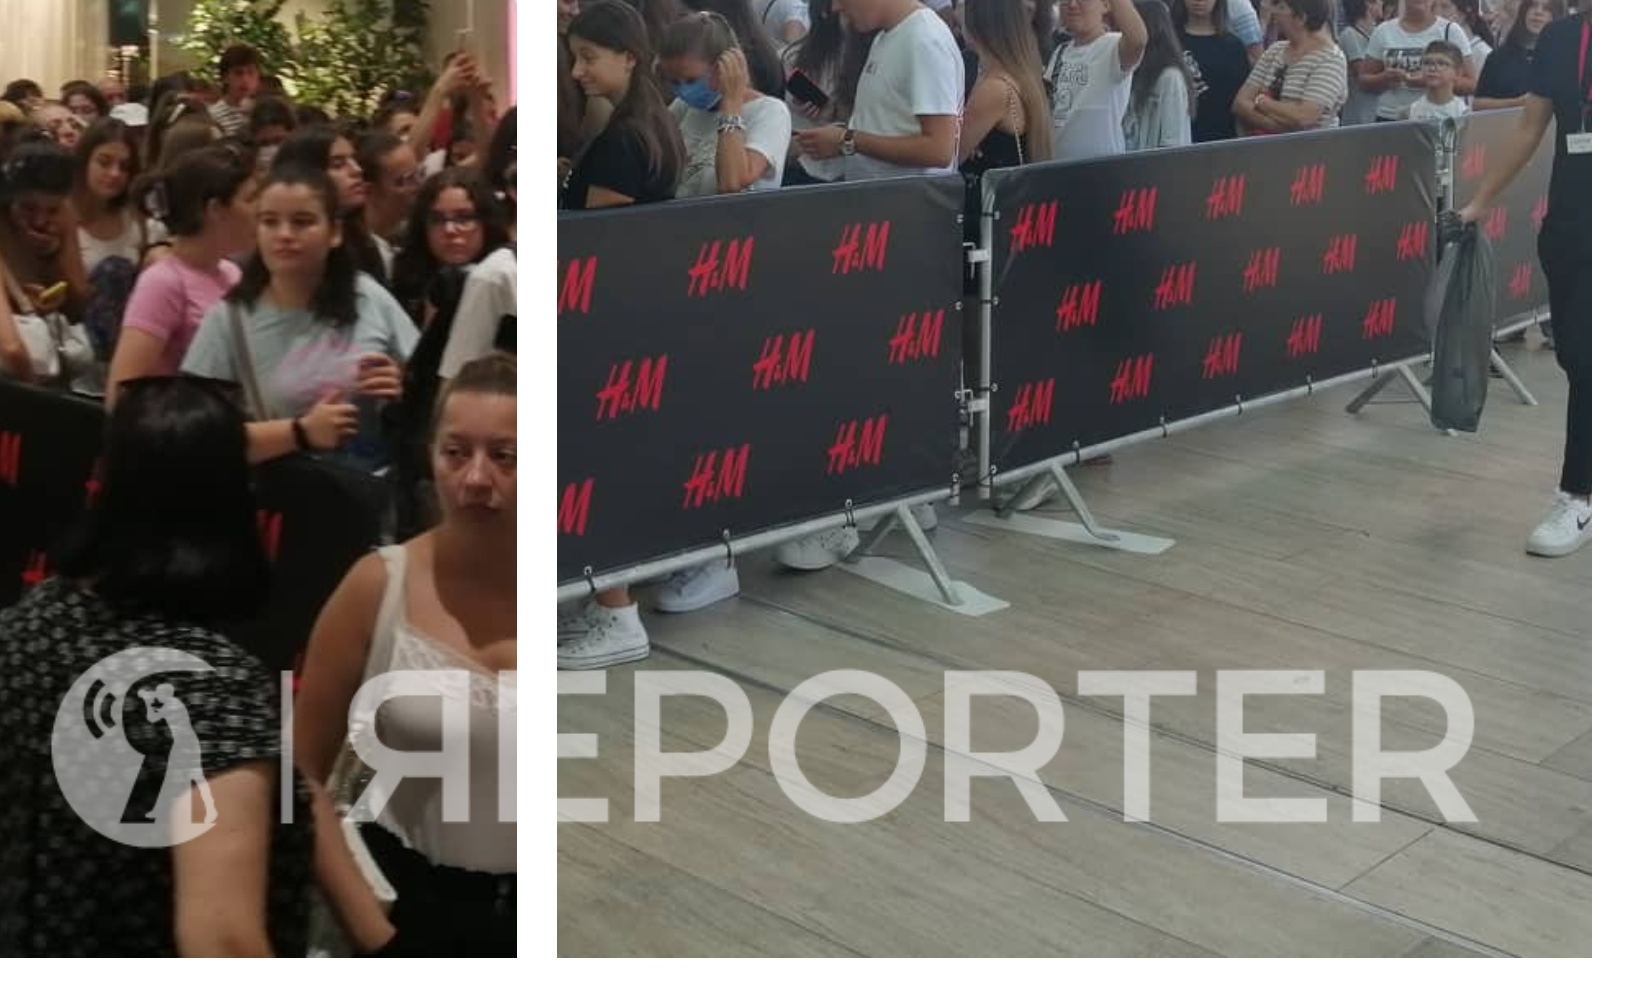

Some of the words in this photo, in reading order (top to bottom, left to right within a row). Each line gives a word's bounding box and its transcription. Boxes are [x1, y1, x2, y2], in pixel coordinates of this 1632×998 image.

[688, 236, 755, 295] H&M
[832, 221, 891, 273] H&M
[752, 330, 815, 389] H&M
[889, 310, 945, 363] H&M
[597, 355, 668, 419] H&M
[828, 416, 888, 473] H&M
[684, 444, 750, 507] H&M
